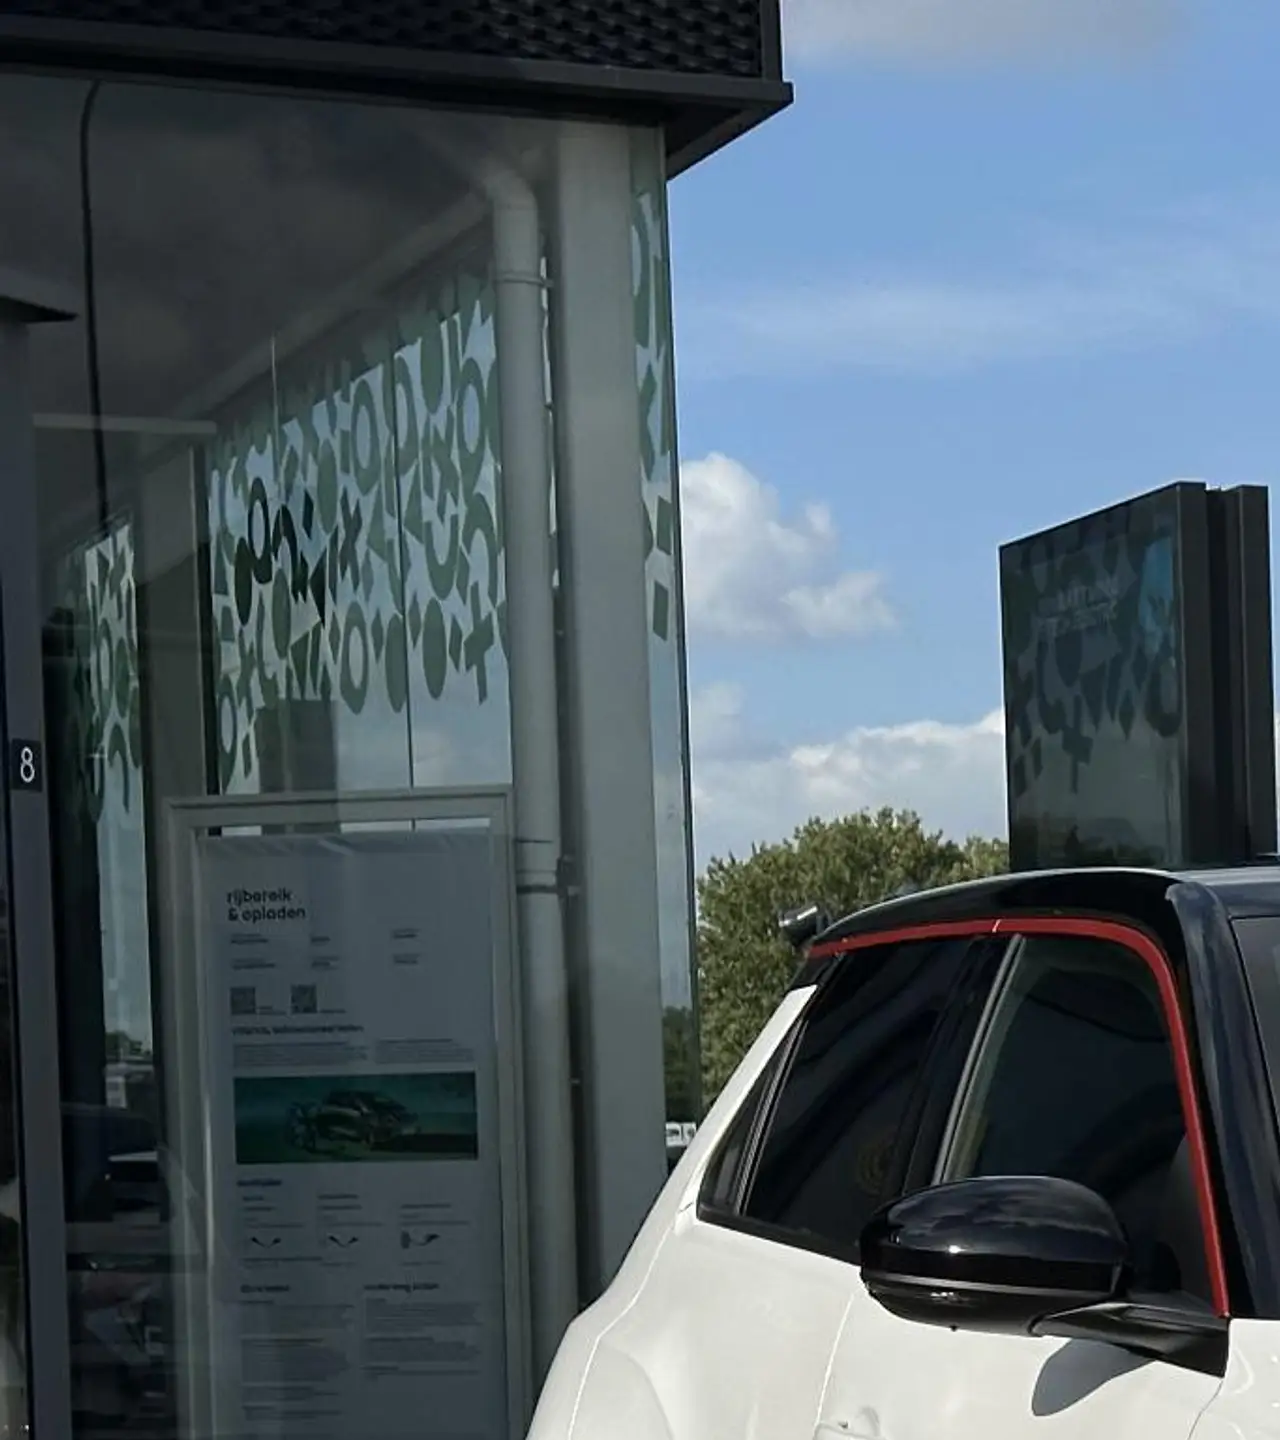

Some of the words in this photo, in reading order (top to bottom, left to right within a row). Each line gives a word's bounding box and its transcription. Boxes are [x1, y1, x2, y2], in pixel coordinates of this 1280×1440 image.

[20, 746, 35, 783] 8
[228, 907, 238, 921] &
[241, 906, 306, 924] opladen
